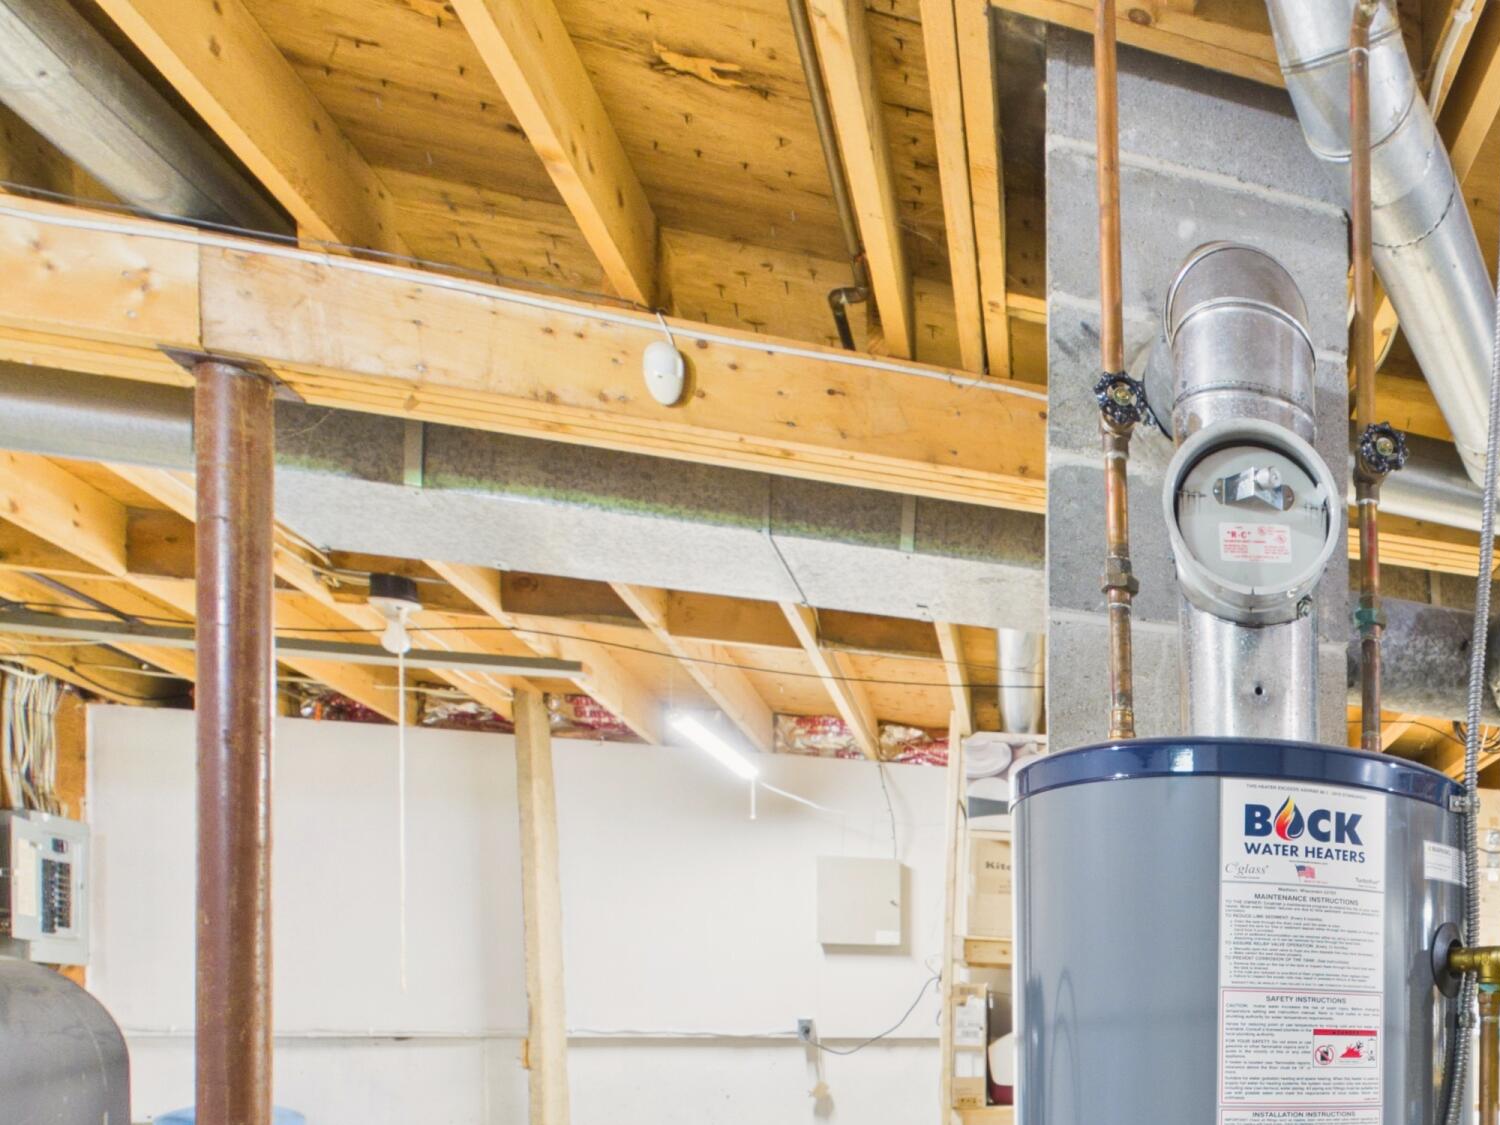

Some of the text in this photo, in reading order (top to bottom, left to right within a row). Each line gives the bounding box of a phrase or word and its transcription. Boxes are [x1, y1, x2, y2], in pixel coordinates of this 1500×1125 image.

[1244, 795, 1363, 845] BOCK
[1244, 842, 1366, 864] WATER HEATERS
[1254, 893, 1359, 906] MAINTENANCE INSTRUCTIONS
[1265, 995, 1347, 1004] SAFETY INSTRUCTIONS
